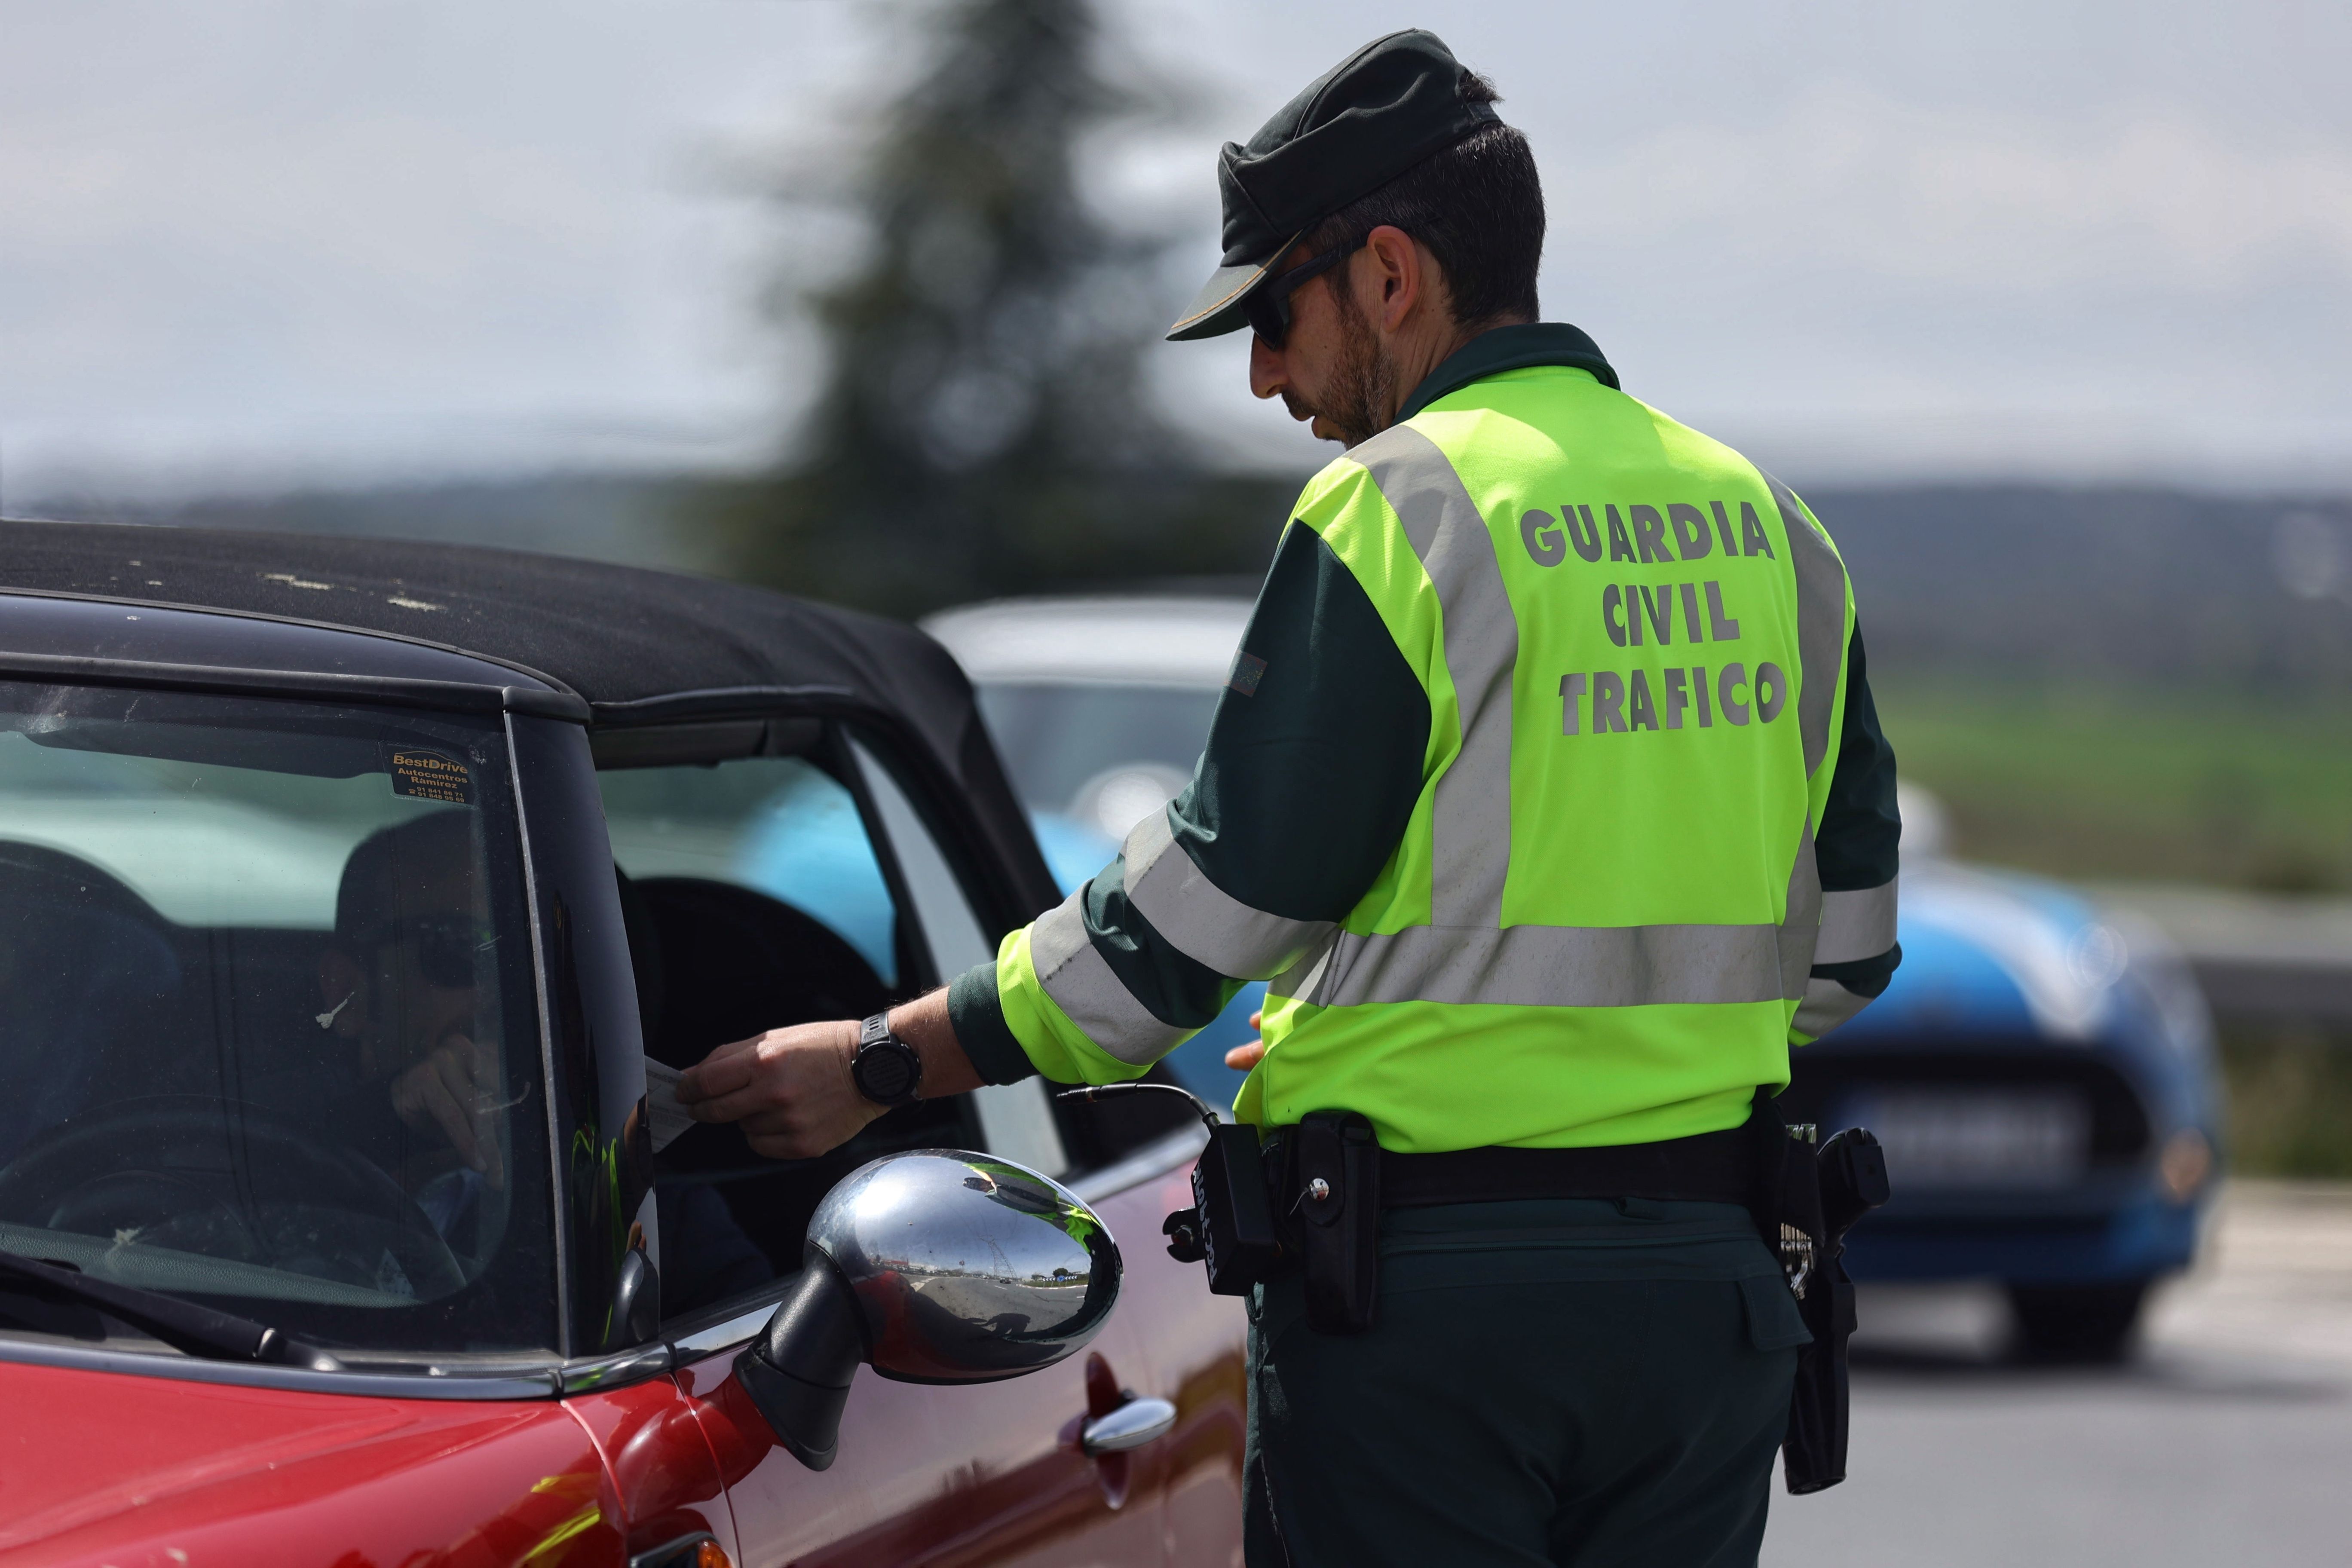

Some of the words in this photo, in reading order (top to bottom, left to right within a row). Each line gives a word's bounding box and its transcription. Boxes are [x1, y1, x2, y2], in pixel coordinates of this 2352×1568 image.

[1520, 500, 1776, 567] GUARDIA
[1602, 581, 1740, 647] CIVIL
[1558, 662, 1786, 736] TRAFICO
[393, 755, 468, 774] BestDrive
[398, 768, 468, 783] Autocentros
[1205, 1232, 1217, 1284] PGC
